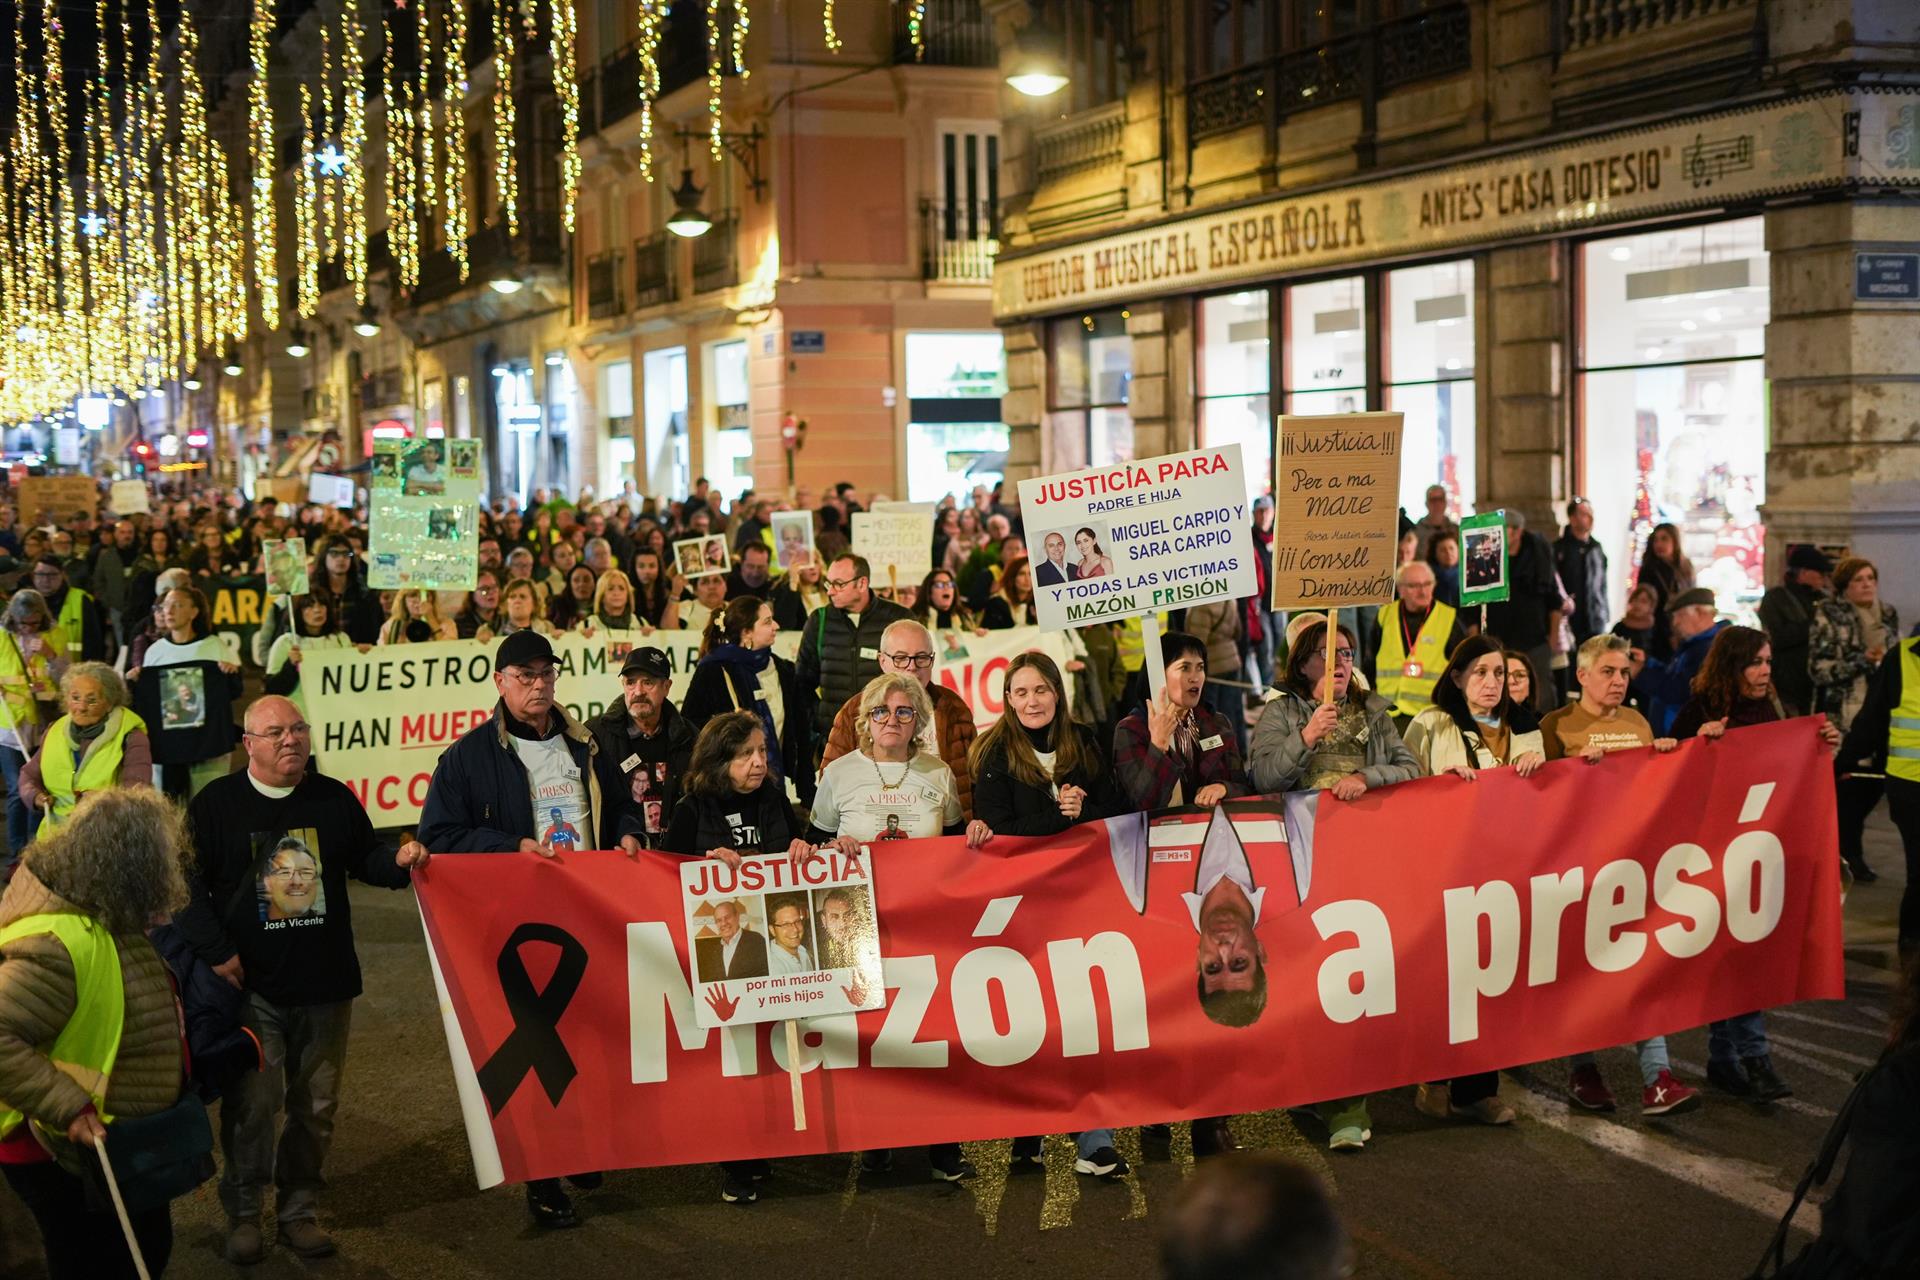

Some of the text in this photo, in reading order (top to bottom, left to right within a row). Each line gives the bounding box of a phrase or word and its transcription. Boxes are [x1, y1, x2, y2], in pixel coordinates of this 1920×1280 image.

[1419, 182, 1483, 228] ANTES
[1094, 232, 1198, 289] MUSICAL
[1209, 198, 1366, 269] ESPAÑOLA
[1158, 453, 1230, 483] PARA
[1291, 468, 1376, 492] Per a ma
[1087, 488, 1182, 514] PADRE E HIJA
[1305, 495, 1374, 517] mare
[1111, 504, 1244, 543] MIGUEL CARPIO Y
[1128, 529, 1232, 561] SARA CARPIO
[1051, 558, 1239, 602] Y TODAS LAS VICTIMAS
[1066, 577, 1229, 622] MAZÓN PRISIÓN
[324, 709, 496, 752] HAN MUER
[689, 853, 867, 896] JUSTICIA
[264, 916, 324, 930] José Vicente
[1310, 898, 1397, 1025] a
[1442, 781, 1786, 1045] presó
[746, 971, 833, 993] por mi marido
[758, 989, 824, 1008] y mis hijos
